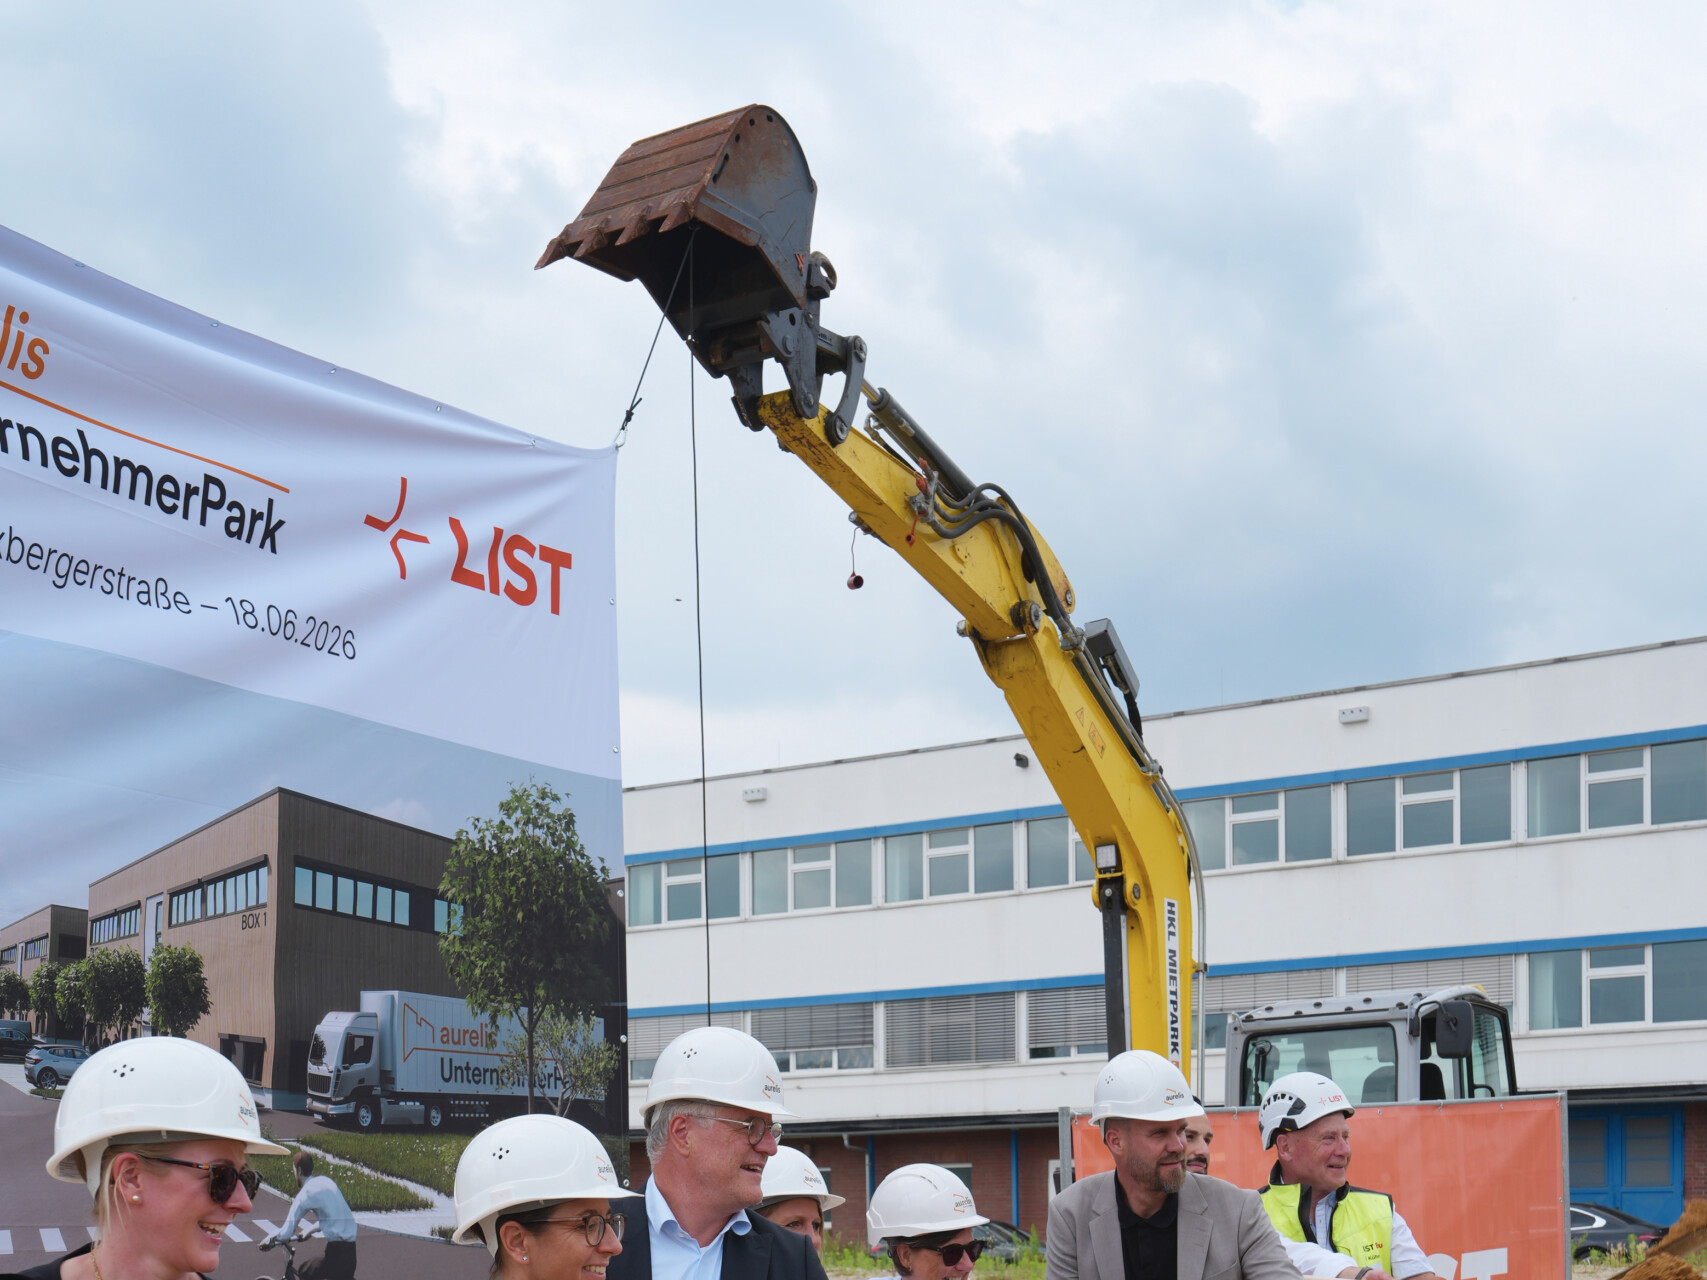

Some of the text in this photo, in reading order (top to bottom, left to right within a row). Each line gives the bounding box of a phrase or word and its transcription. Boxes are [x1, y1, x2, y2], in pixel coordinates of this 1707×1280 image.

[0, 416, 286, 555] rnehmerPark
[0, 526, 192, 614] bergerstraße
[225, 597, 356, 660] 18.06.2026
[448, 516, 573, 616] LIST
[241, 913, 261, 931] BOX
[1166, 901, 1180, 1055] HKL MIETPARK
[1165, 1092, 1185, 1102] aurelis
